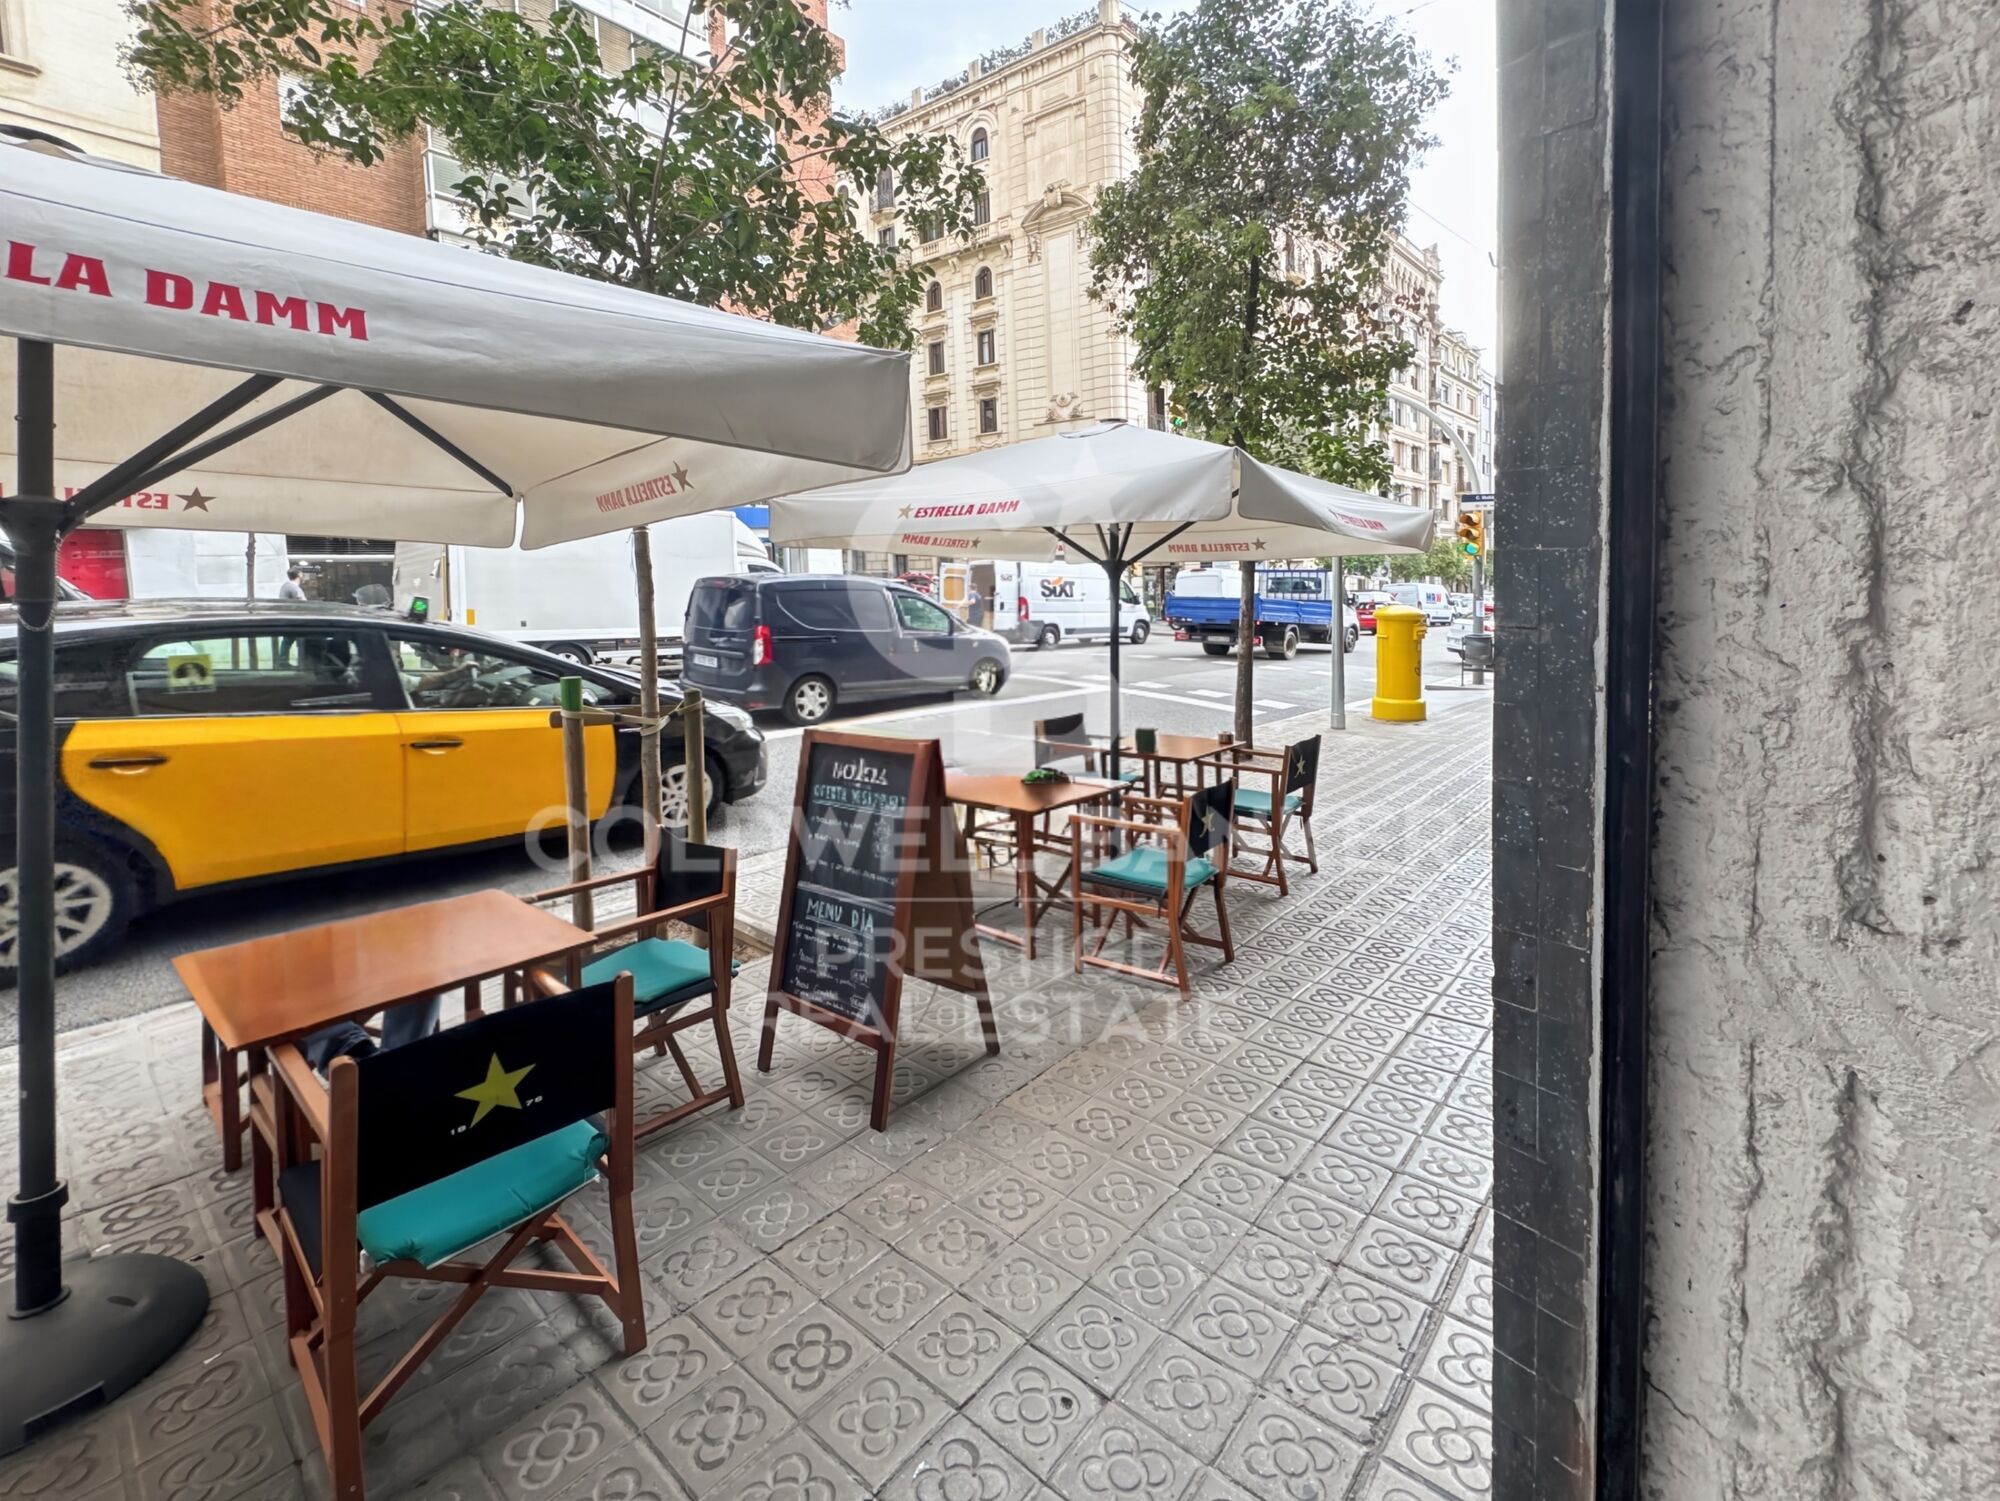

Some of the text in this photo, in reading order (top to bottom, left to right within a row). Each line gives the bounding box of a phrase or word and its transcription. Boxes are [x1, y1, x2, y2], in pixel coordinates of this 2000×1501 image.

[144, 268, 369, 340] DAMM
[914, 500, 1020, 518] ESTRELLA DAMM
[806, 898, 842, 922] MENU
